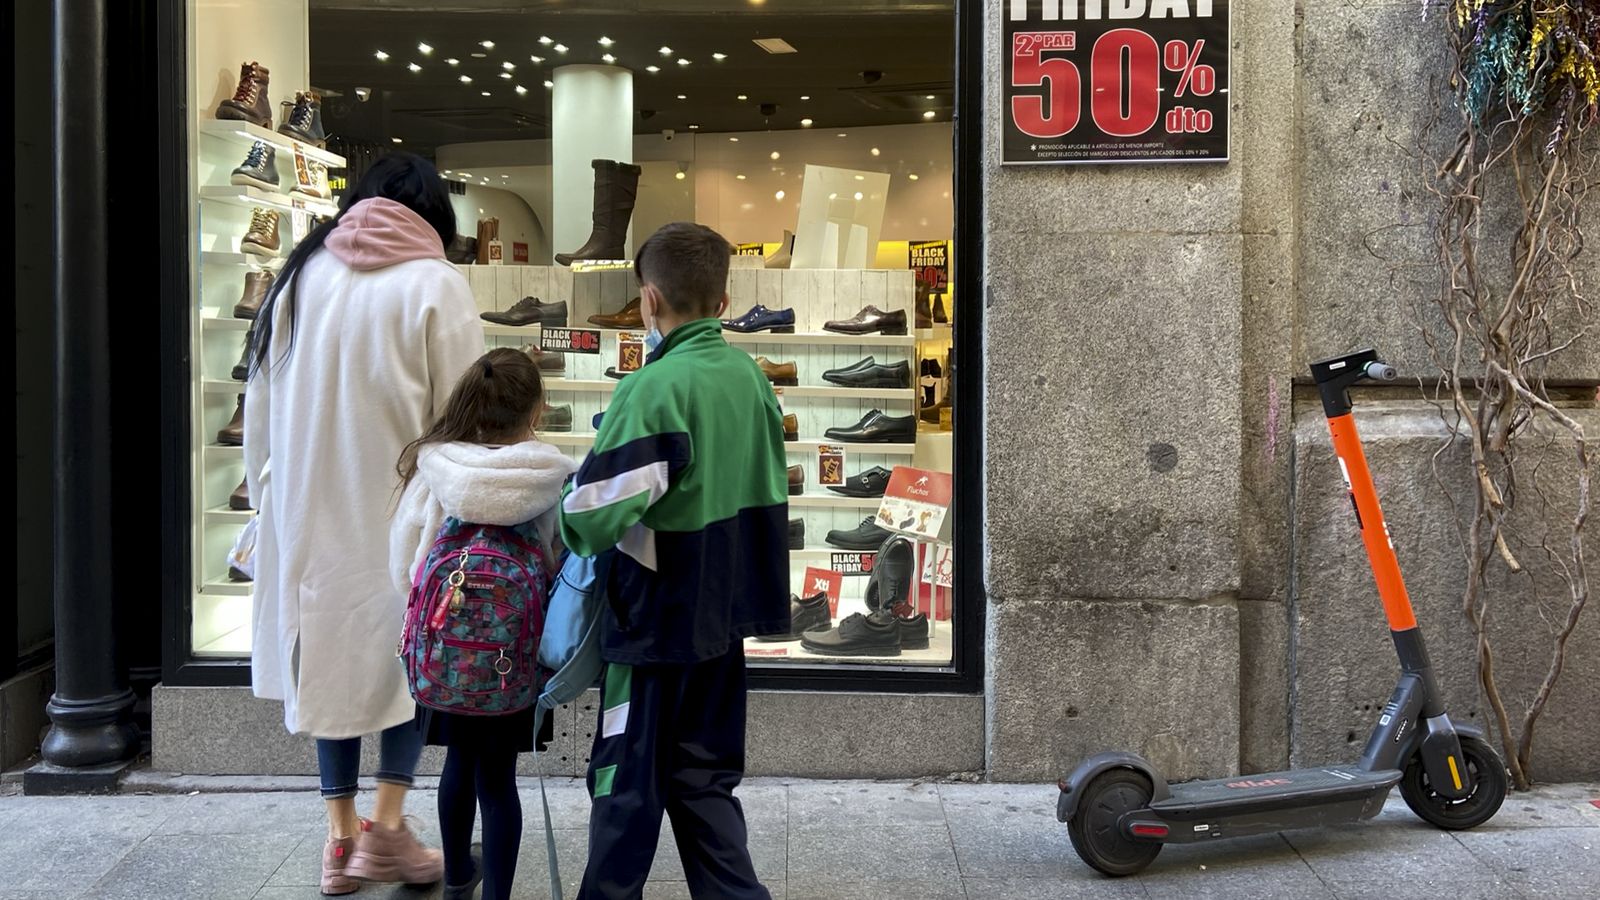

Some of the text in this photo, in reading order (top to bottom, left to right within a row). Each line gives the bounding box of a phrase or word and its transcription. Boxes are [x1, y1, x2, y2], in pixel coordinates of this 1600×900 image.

[1044, 34, 1074, 47] PAR
[1166, 106, 1213, 133] dto
[911, 248, 944, 258] BLACK
[911, 257, 946, 267] FRIDAY
[542, 329, 570, 339] BLACK
[542, 338, 571, 349] FRIDAY
[624, 348, 637, 366] PIEL
[825, 462, 838, 479] PIEL
[832, 554, 860, 563] BLACK
[832, 563, 862, 573] FRIDAY
